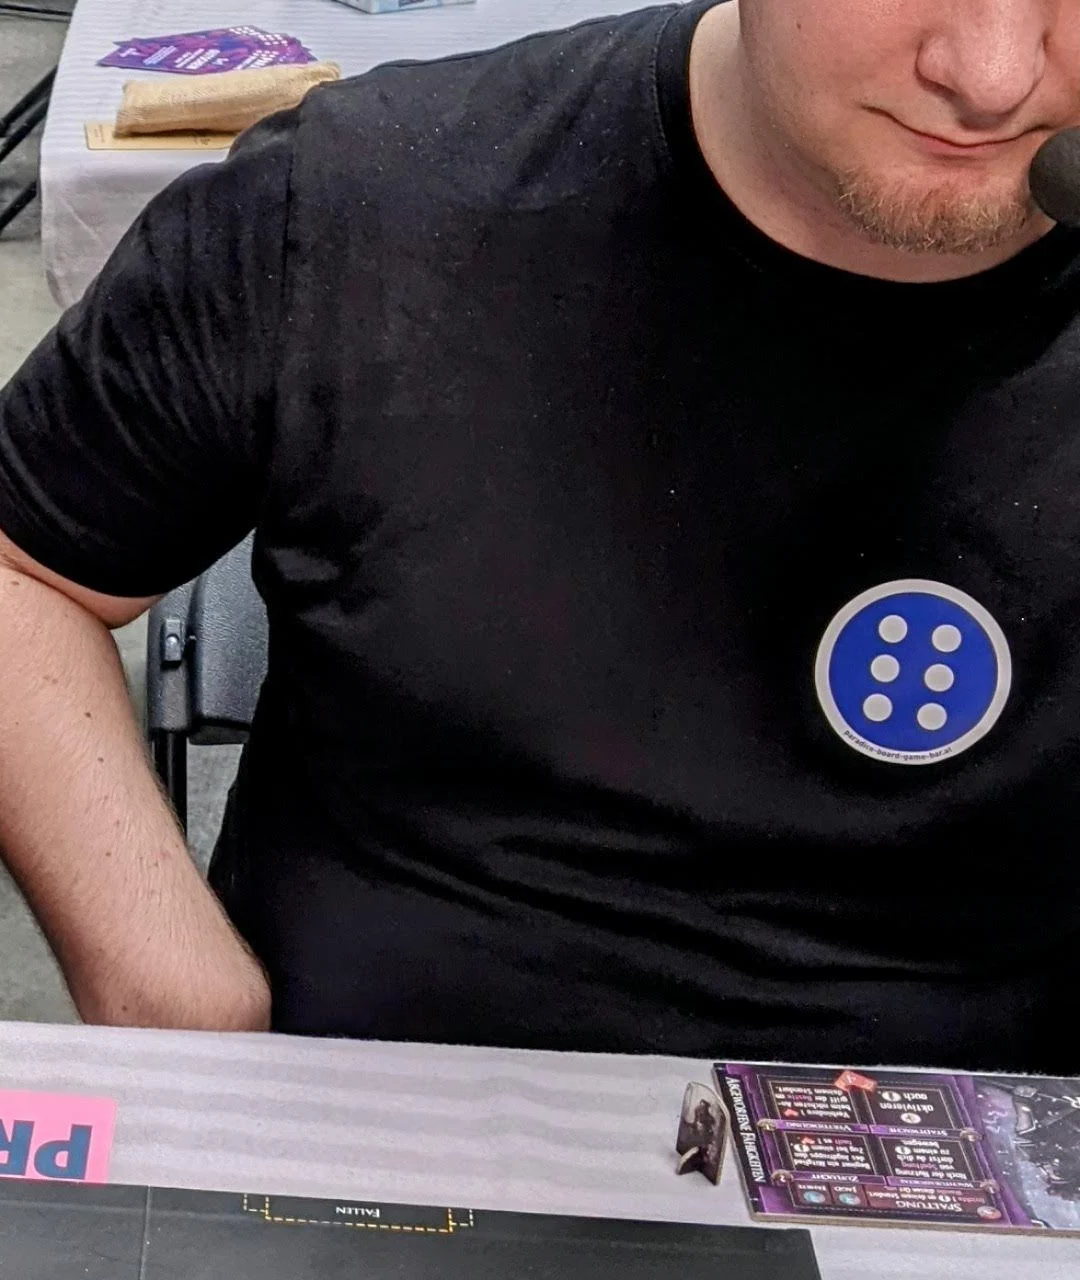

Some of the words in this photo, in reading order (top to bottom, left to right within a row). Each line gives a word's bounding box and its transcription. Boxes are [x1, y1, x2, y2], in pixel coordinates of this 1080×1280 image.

[725, 1077, 751, 1131] ABGEWORFENE
[878, 1101, 935, 1113] aktivieren
[894, 1199, 963, 1211] SPALTUNG
[334, 1205, 381, 1219] FALLEN
